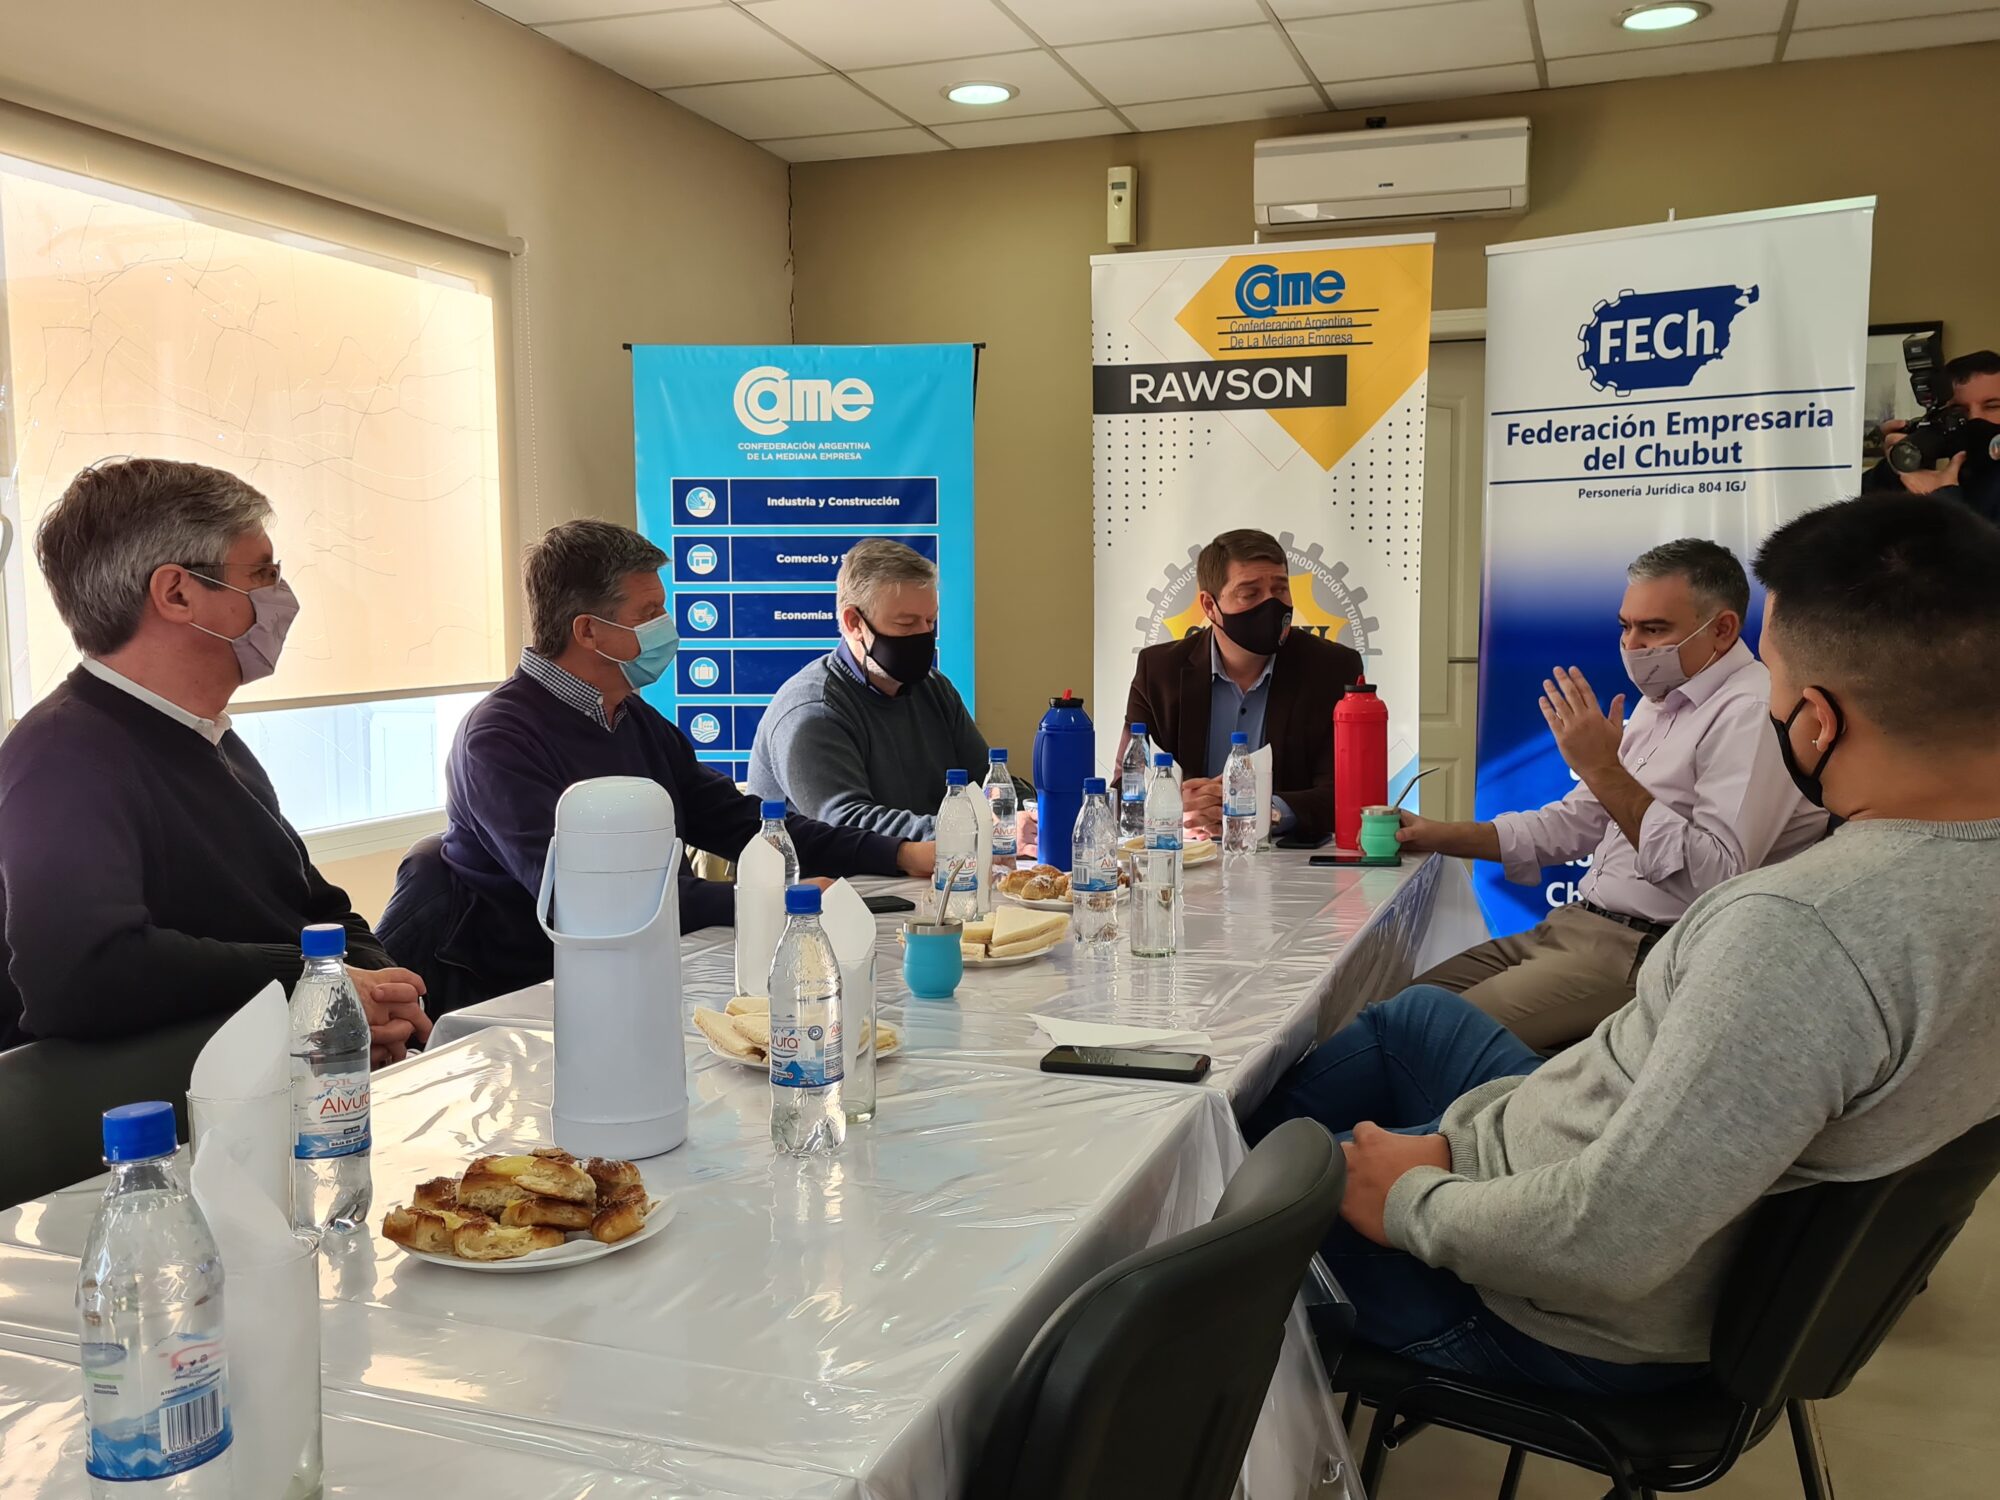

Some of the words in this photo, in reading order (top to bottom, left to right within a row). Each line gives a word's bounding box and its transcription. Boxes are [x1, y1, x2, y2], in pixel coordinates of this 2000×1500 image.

[1230, 317, 1302, 332] Confederación
[1305, 315, 1353, 331] Argentina
[1230, 336, 1244, 348] De
[1247, 335, 1259, 347] La
[1262, 333, 1304, 346] Mediana
[1308, 332, 1353, 345] Empresa
[1130, 366, 1313, 404] RAWSON
[1507, 414, 1656, 446] Federación
[1667, 403, 1834, 441] Empresaria
[738, 441, 815, 450] CONFEDERACIÓN
[818, 441, 871, 450] ARGENTINA
[747, 452, 759, 460] DE
[761, 452, 774, 460] LA
[776, 452, 817, 460] MEDIANA
[820, 452, 862, 460] EMPRESA
[1584, 442, 1625, 471] del
[1635, 440, 1743, 469] Chubut
[1578, 485, 1642, 498] Personería
[1646, 483, 1694, 496] Jurídica
[1698, 481, 1721, 493] 804
[1725, 481, 1747, 492] IGJ
[767, 497, 816, 506] Industria
[818, 499, 825, 508] y
[828, 496, 900, 506] Construcción
[776, 554, 829, 563] Comercio
[831, 556, 838, 564] y
[1286, 551, 1345, 600] PRODUCCIÓN
[1147, 610, 1166, 645] ÁMARA
[1160, 594, 1173, 609] DE
[1169, 567, 1198, 597] INDUS
[1341, 596, 1351, 606] Y
[774, 610, 833, 620] Economías
[1345, 603, 1366, 654] TURISMO
